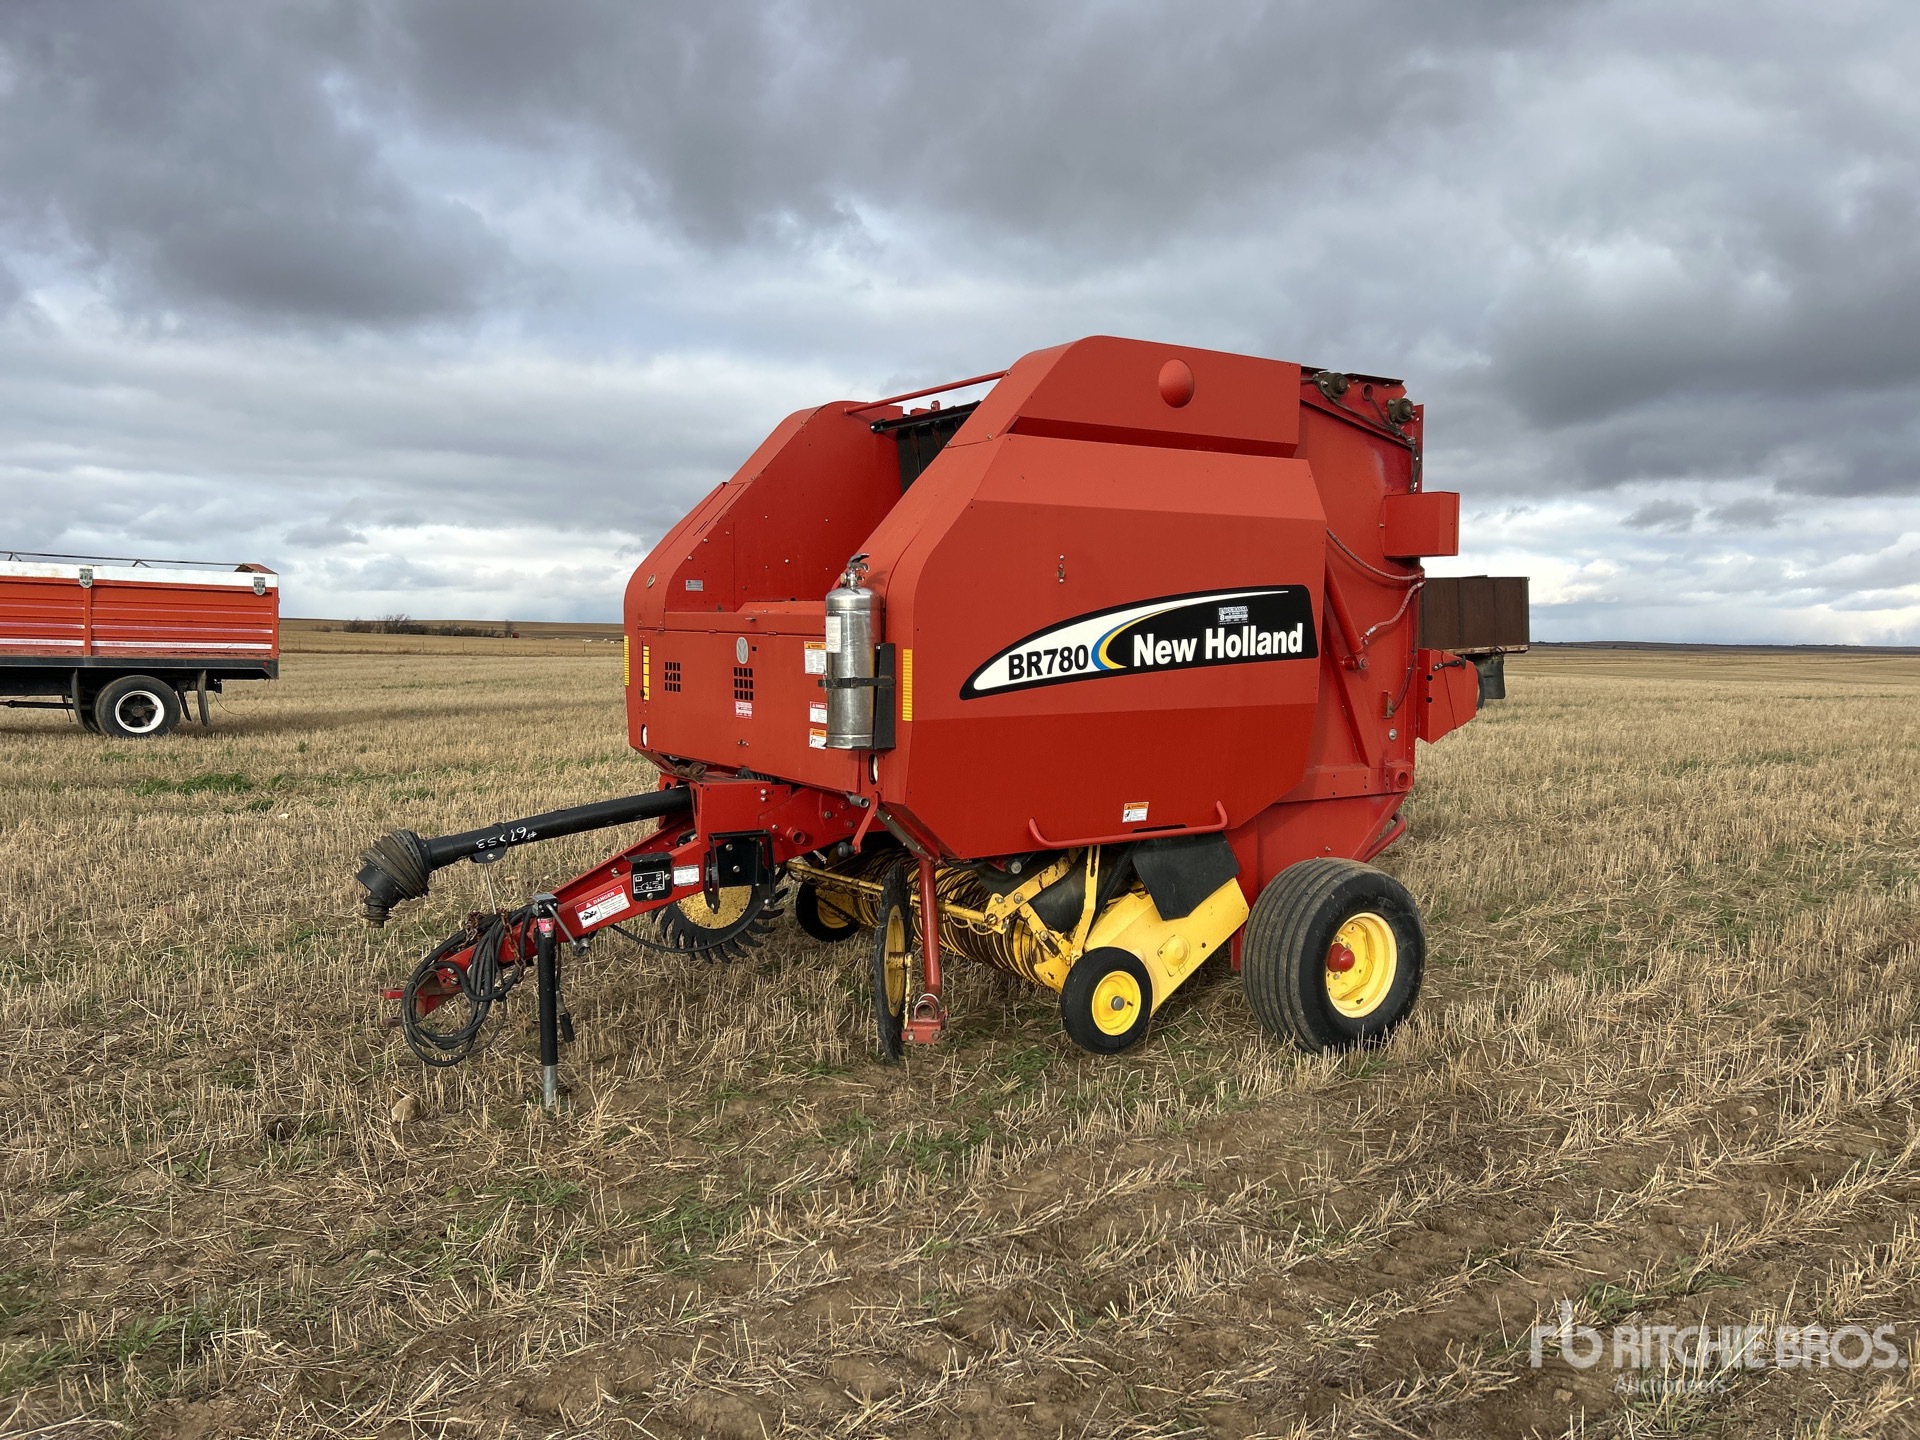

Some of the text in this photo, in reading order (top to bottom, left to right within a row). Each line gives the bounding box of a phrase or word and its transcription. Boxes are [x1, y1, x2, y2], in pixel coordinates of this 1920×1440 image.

[1007, 643, 1089, 681] BR780
[1133, 622, 1304, 667] New Holland
[592, 891, 616, 905] DANGER
